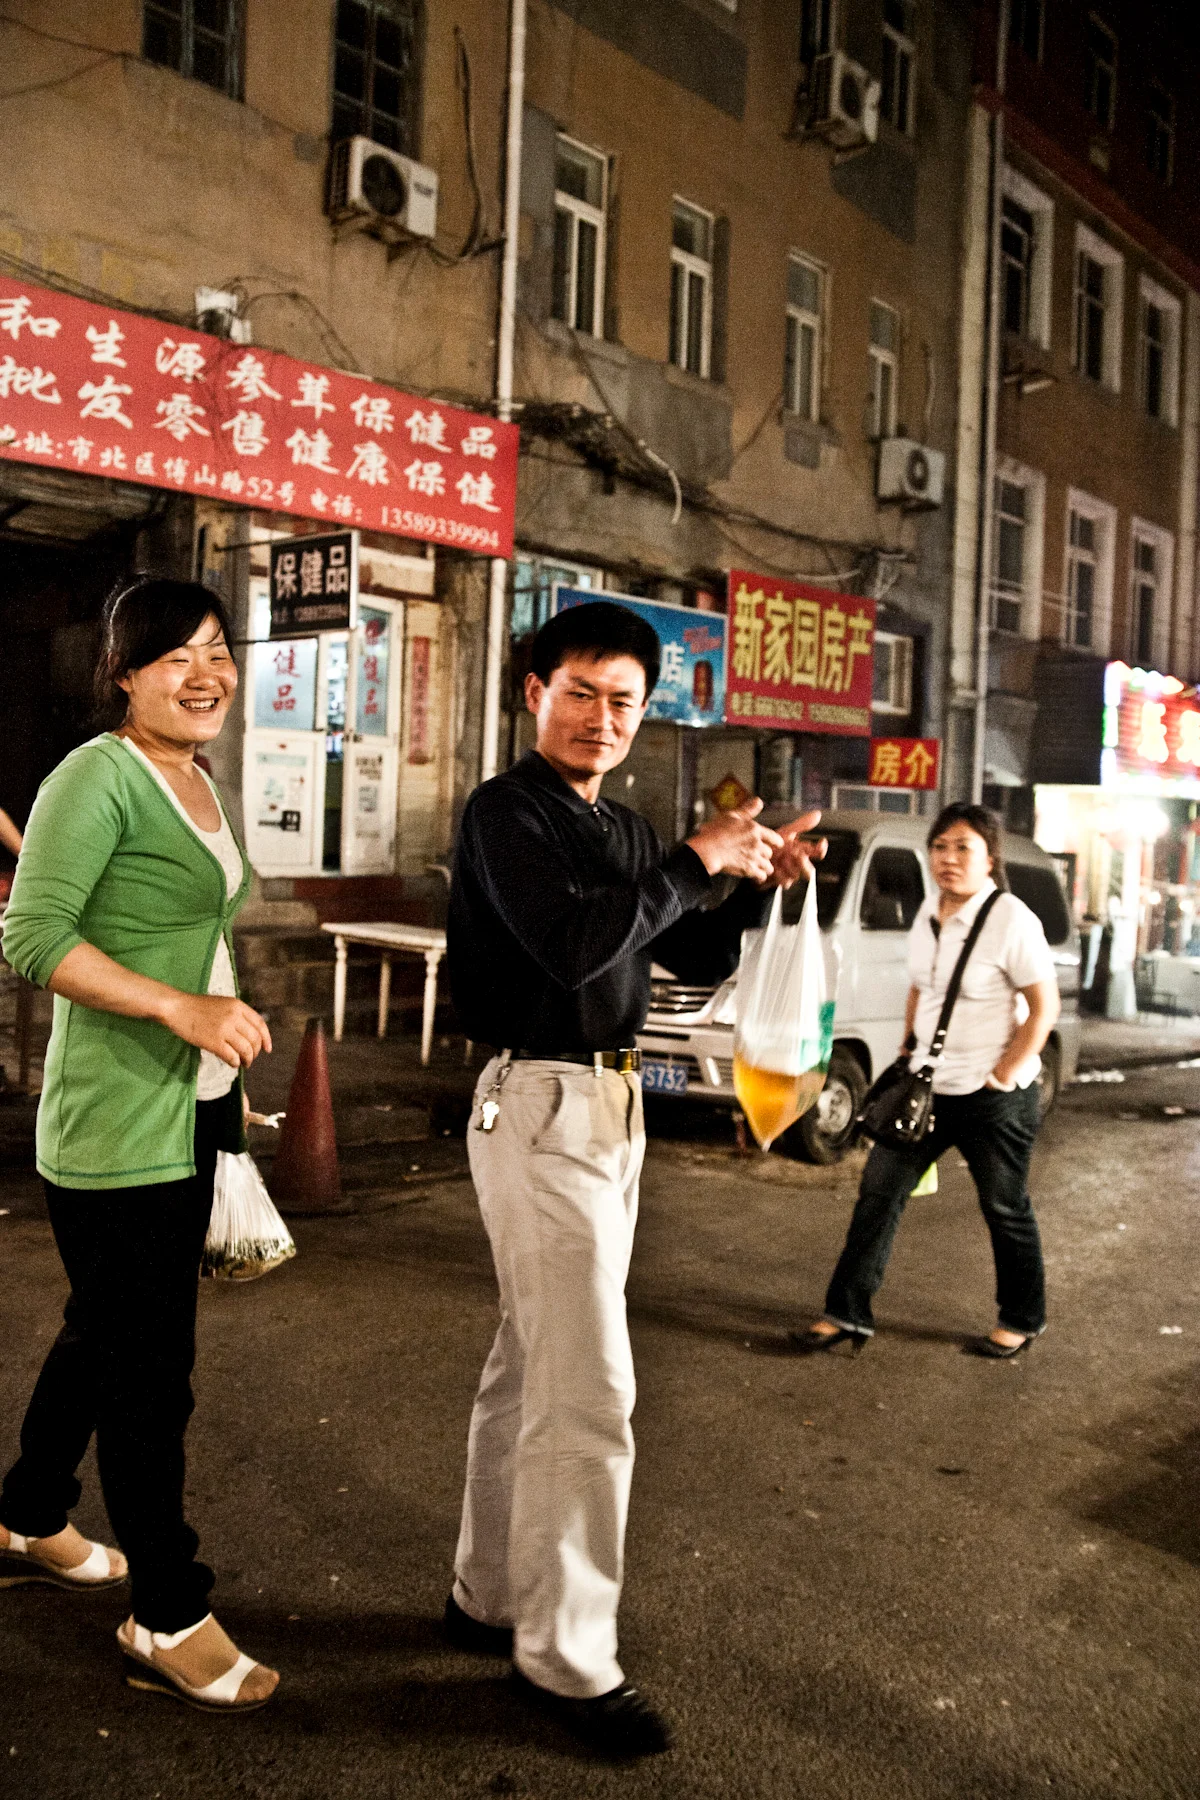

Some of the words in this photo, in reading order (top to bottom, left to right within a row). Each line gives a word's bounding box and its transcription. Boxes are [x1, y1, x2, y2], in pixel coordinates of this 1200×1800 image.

[274, 545, 350, 600] 保健品
[732, 583, 873, 693] 新家园房产
[871, 741, 935, 785] 房介
